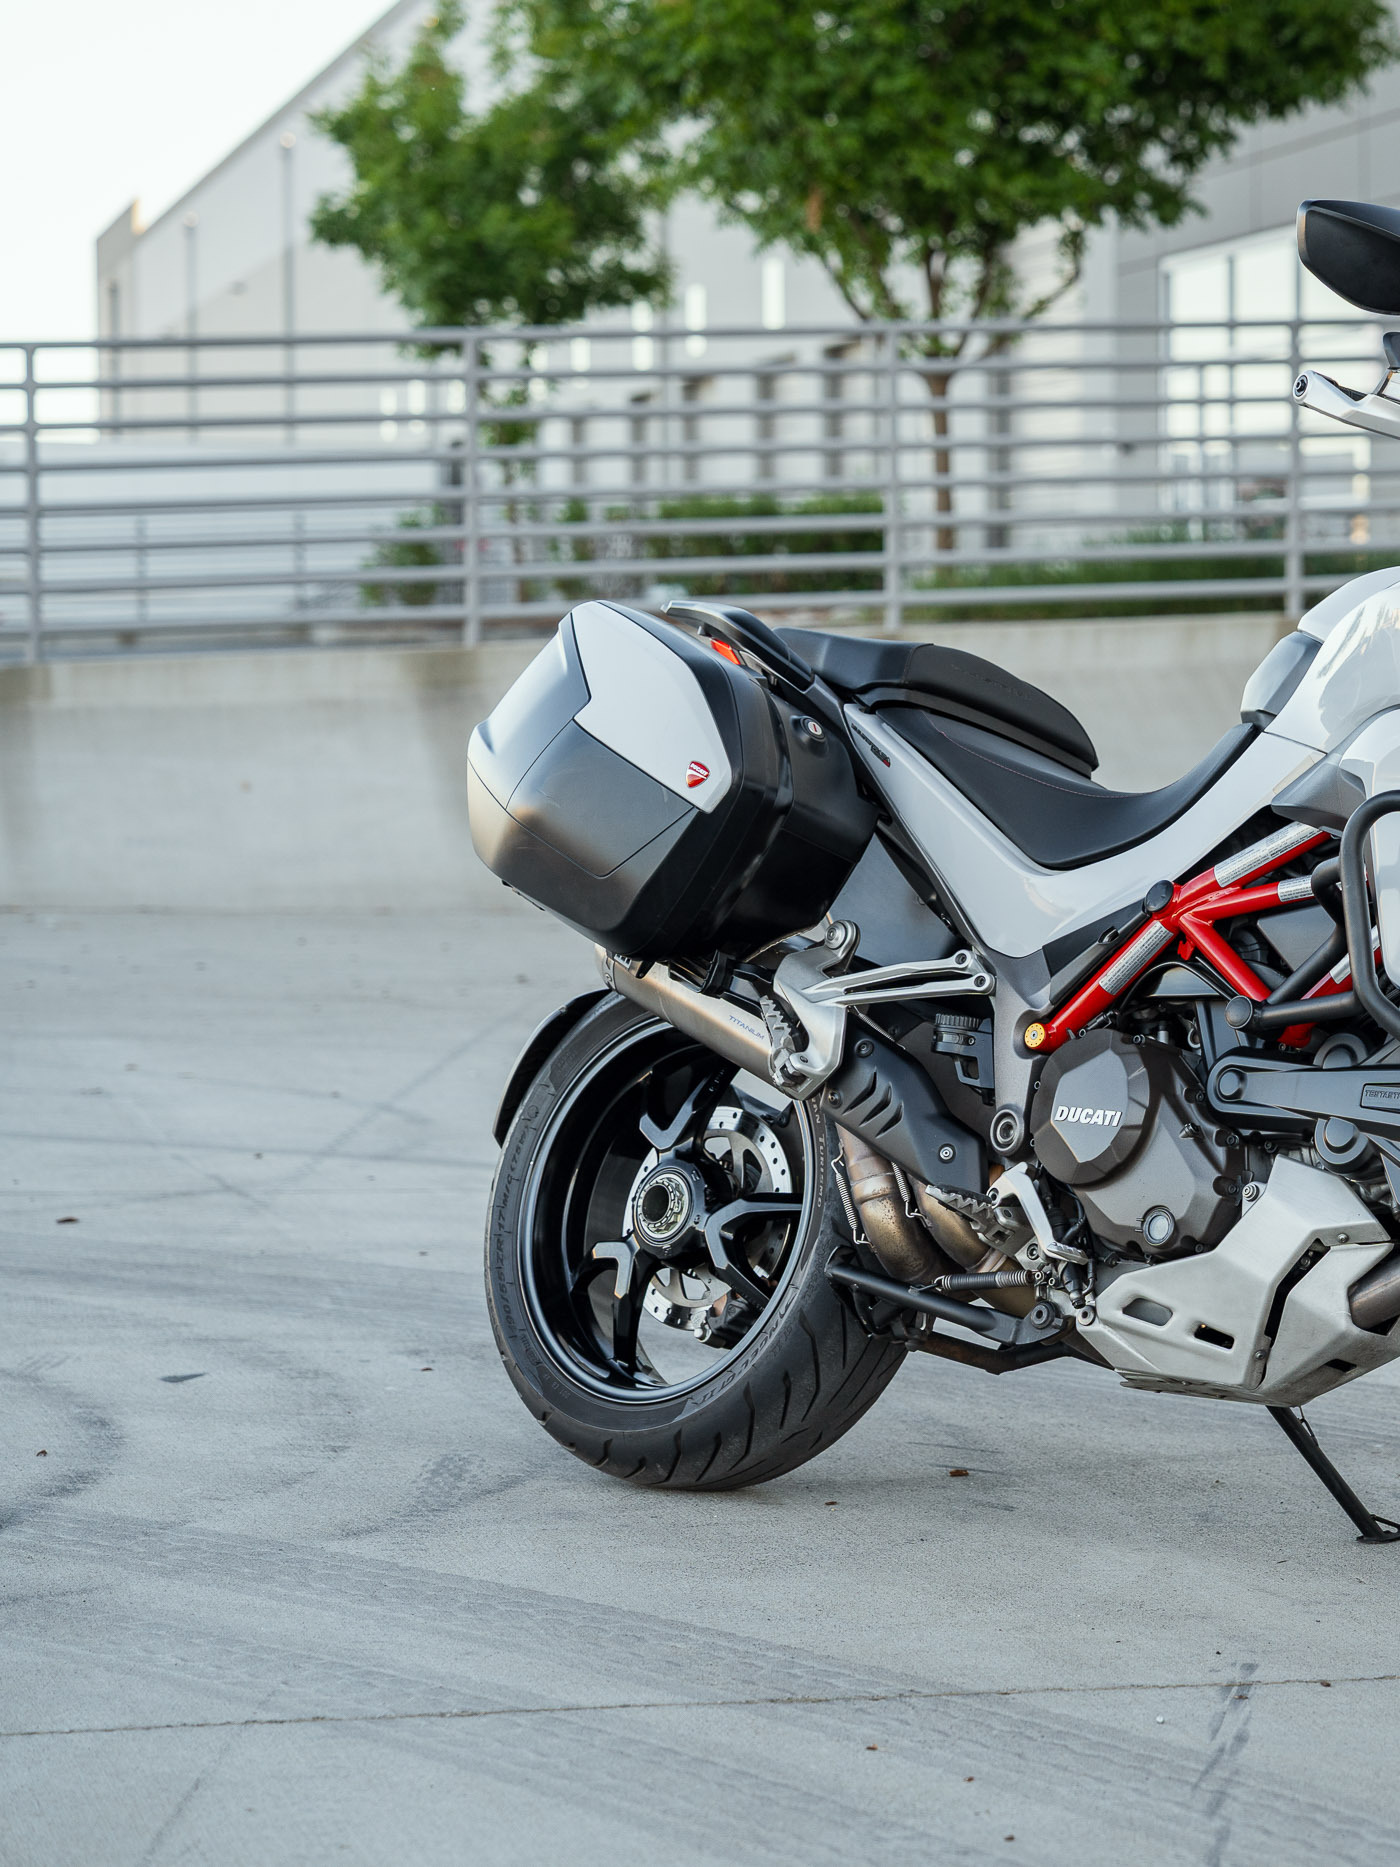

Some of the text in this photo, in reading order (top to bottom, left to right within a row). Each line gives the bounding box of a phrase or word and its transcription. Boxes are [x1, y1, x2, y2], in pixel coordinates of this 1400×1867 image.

[690, 763, 709, 776] DUCATI
[728, 1014, 765, 1040] TITANIUM
[1054, 1105, 1123, 1127] DUCATI
